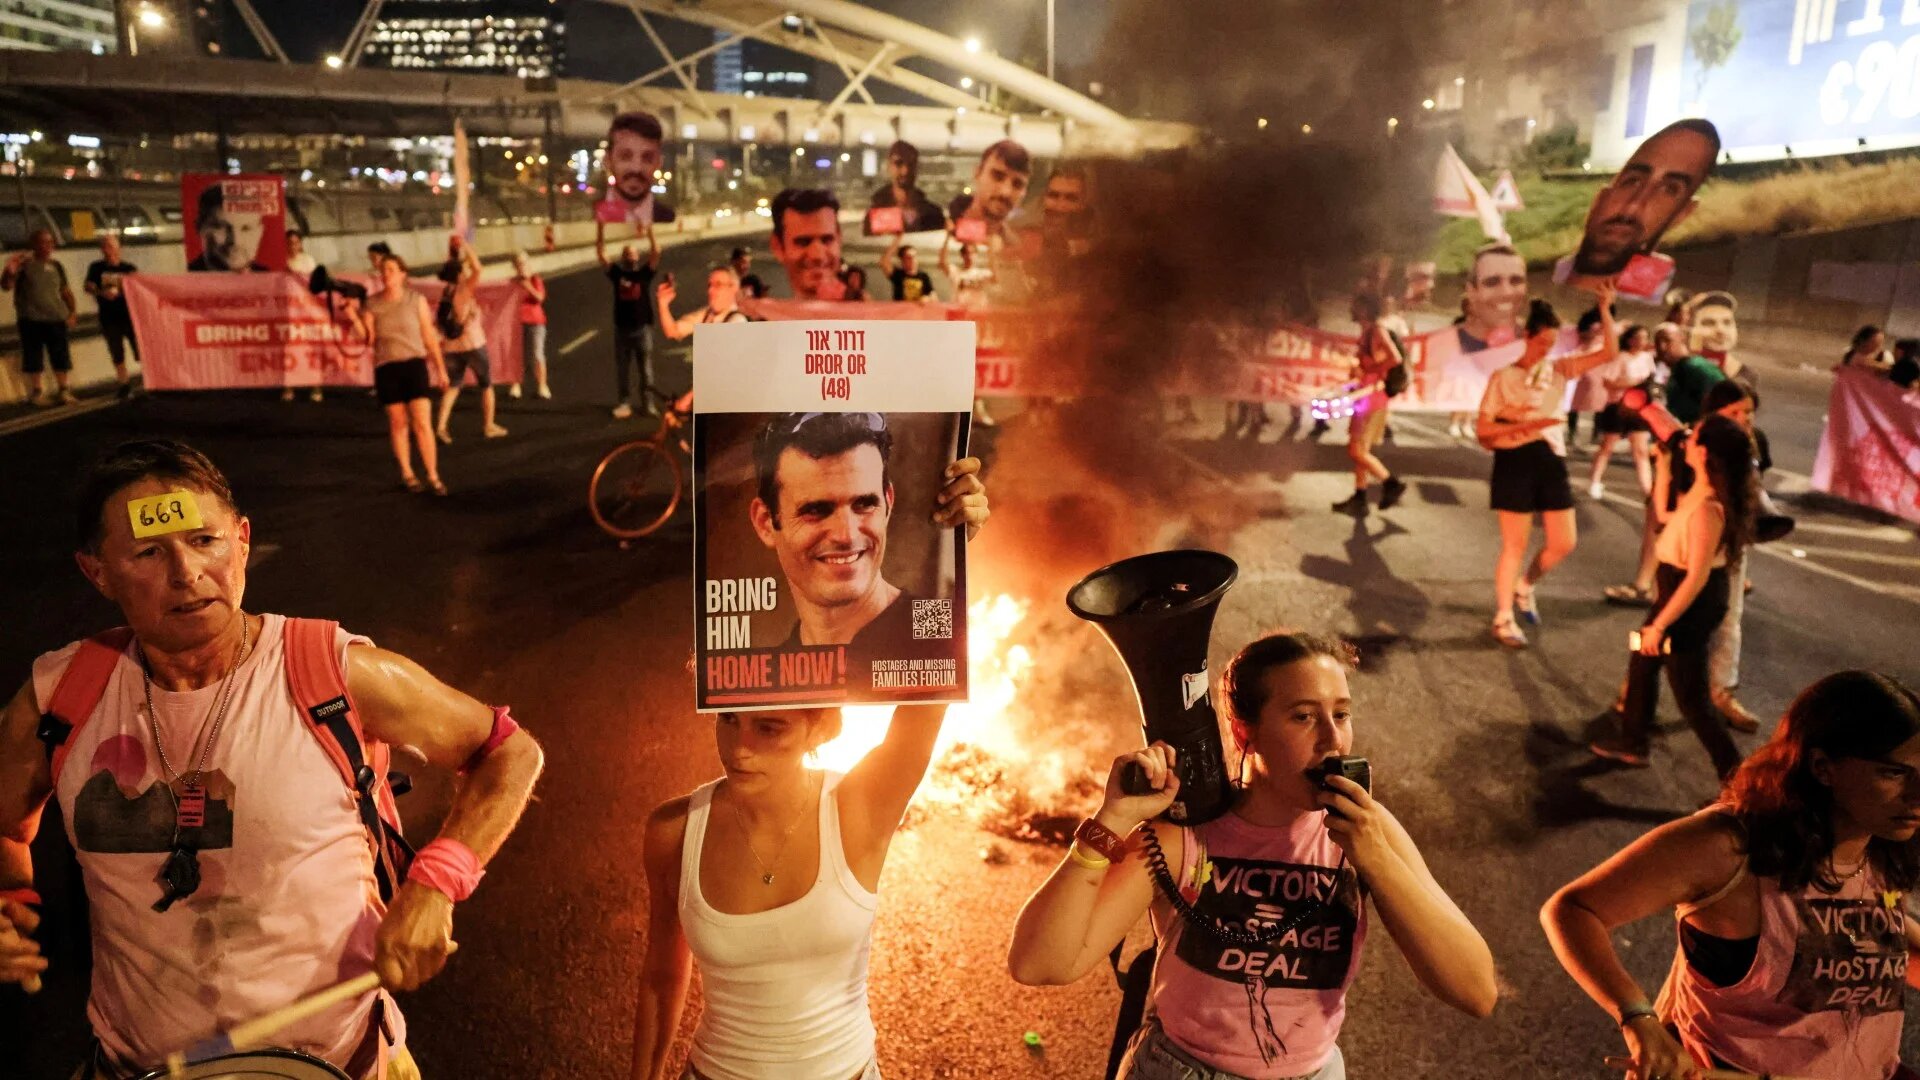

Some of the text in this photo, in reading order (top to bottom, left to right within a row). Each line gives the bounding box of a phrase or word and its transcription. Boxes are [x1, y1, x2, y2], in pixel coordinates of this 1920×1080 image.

[196, 324, 269, 343] BRING
[274, 322, 342, 342] THEM
[806, 331, 865, 350] דרור אור
[805, 354, 866, 374] DROR OR
[821, 376, 851, 400] (48)
[139, 501, 185, 527] 669
[706, 577, 777, 613] BRING
[706, 615, 751, 650] HIM
[707, 647, 847, 690] HOME NOW!
[872, 659, 956, 672] HOSTAGES AND MISSING
[872, 670, 957, 688] FAMILIES FORUM
[316, 699, 346, 717] OUTDOOR
[1212, 864, 1338, 906] VICTORY
[1217, 948, 1309, 981] DEAL
[1812, 951, 1909, 981] HOSTAG
[1826, 984, 1892, 1008] DEAL
